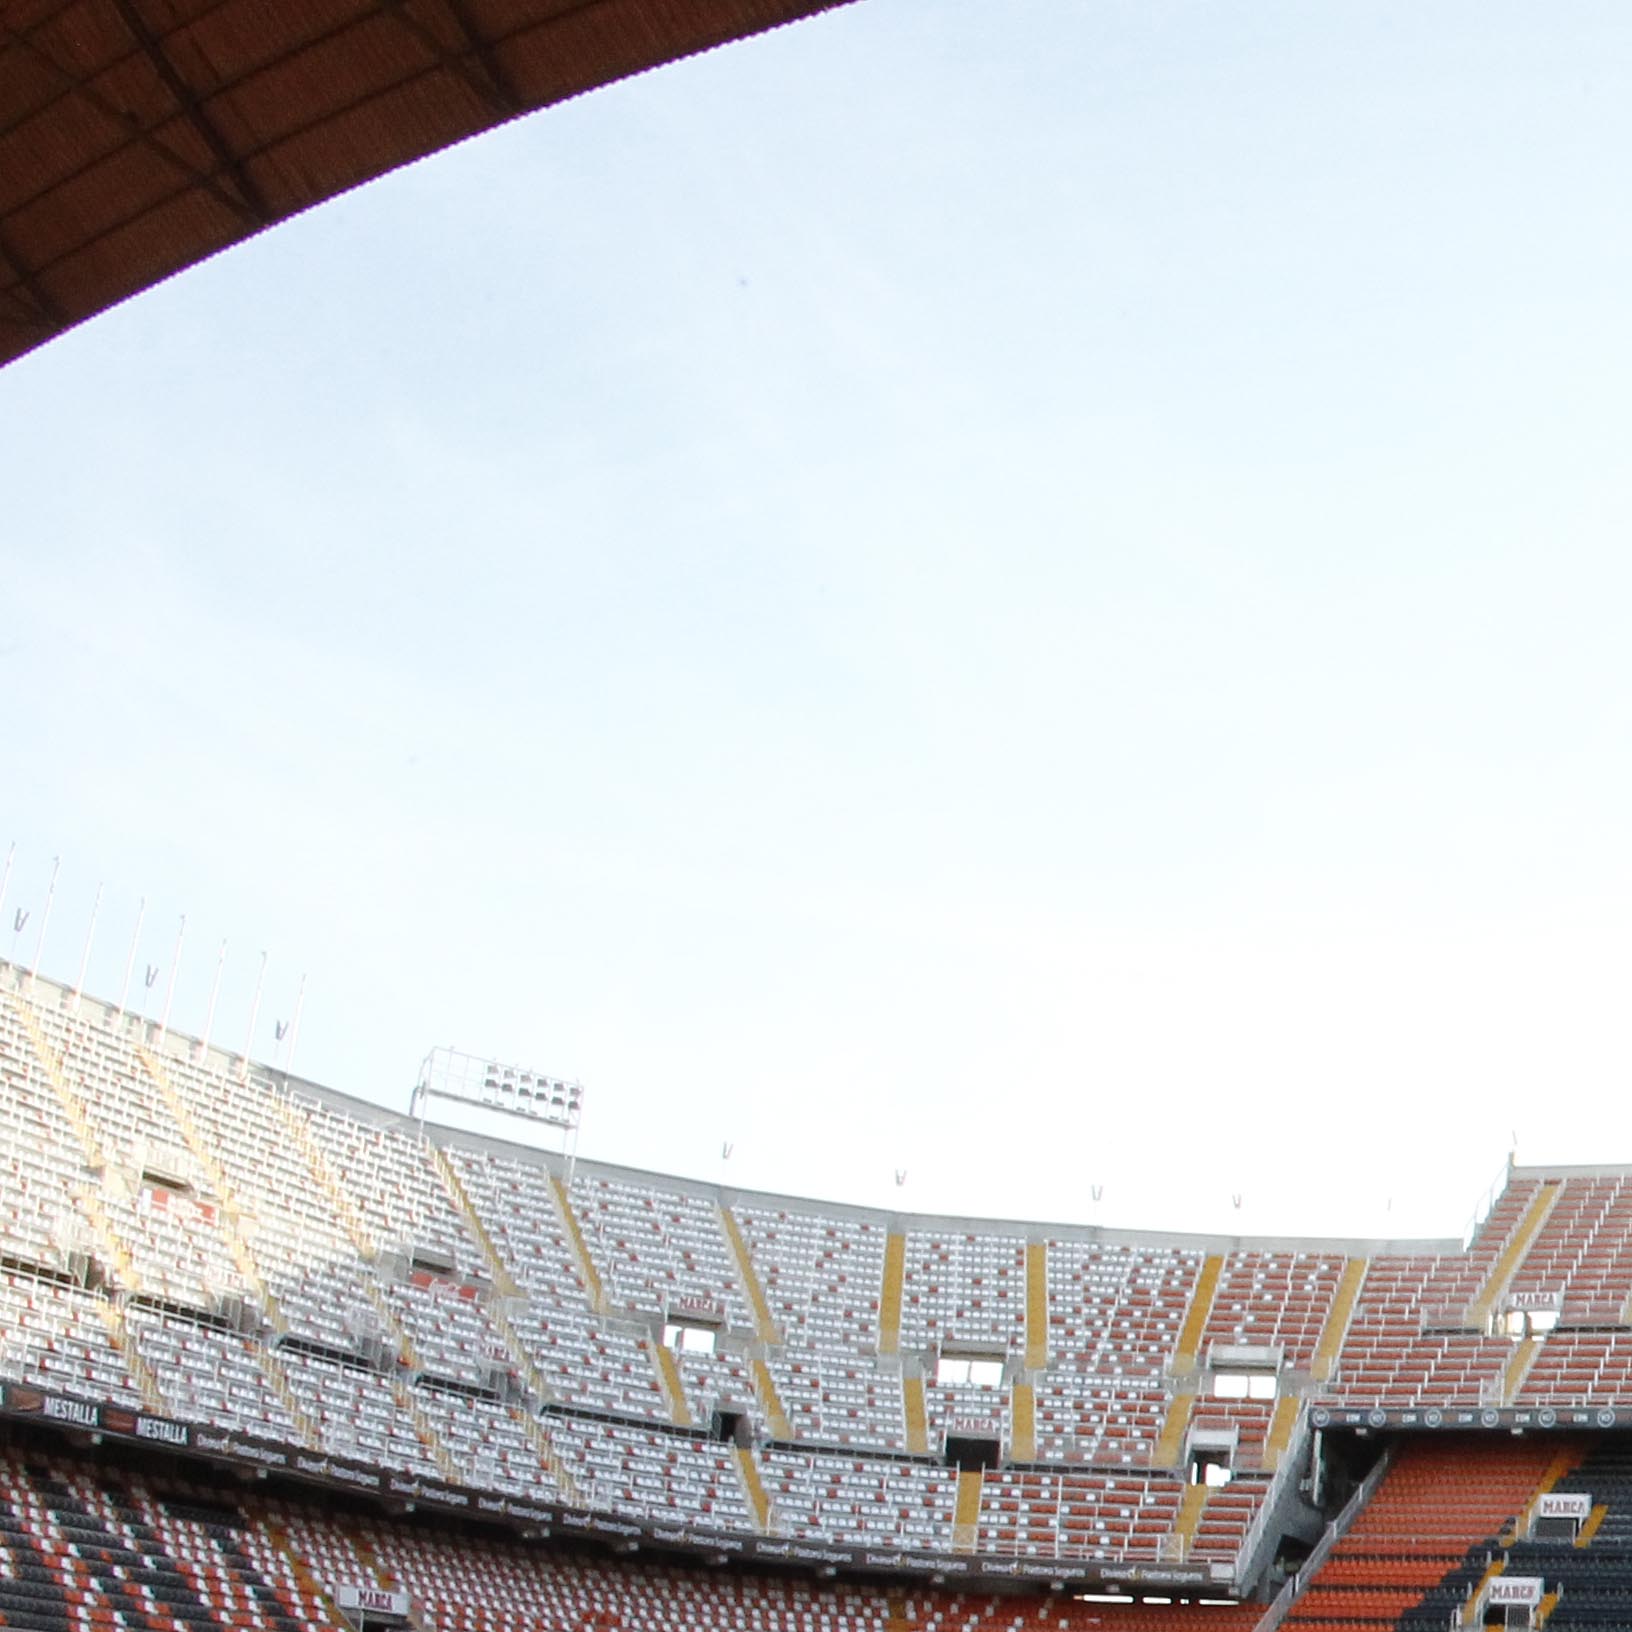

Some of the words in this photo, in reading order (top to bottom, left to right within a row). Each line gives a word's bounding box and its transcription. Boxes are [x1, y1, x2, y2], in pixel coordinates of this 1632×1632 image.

[44, 1395, 99, 1426] MESTALLA
[136, 1416, 189, 1445] MESTALLA
[1543, 1502, 1585, 1514] MARCA
